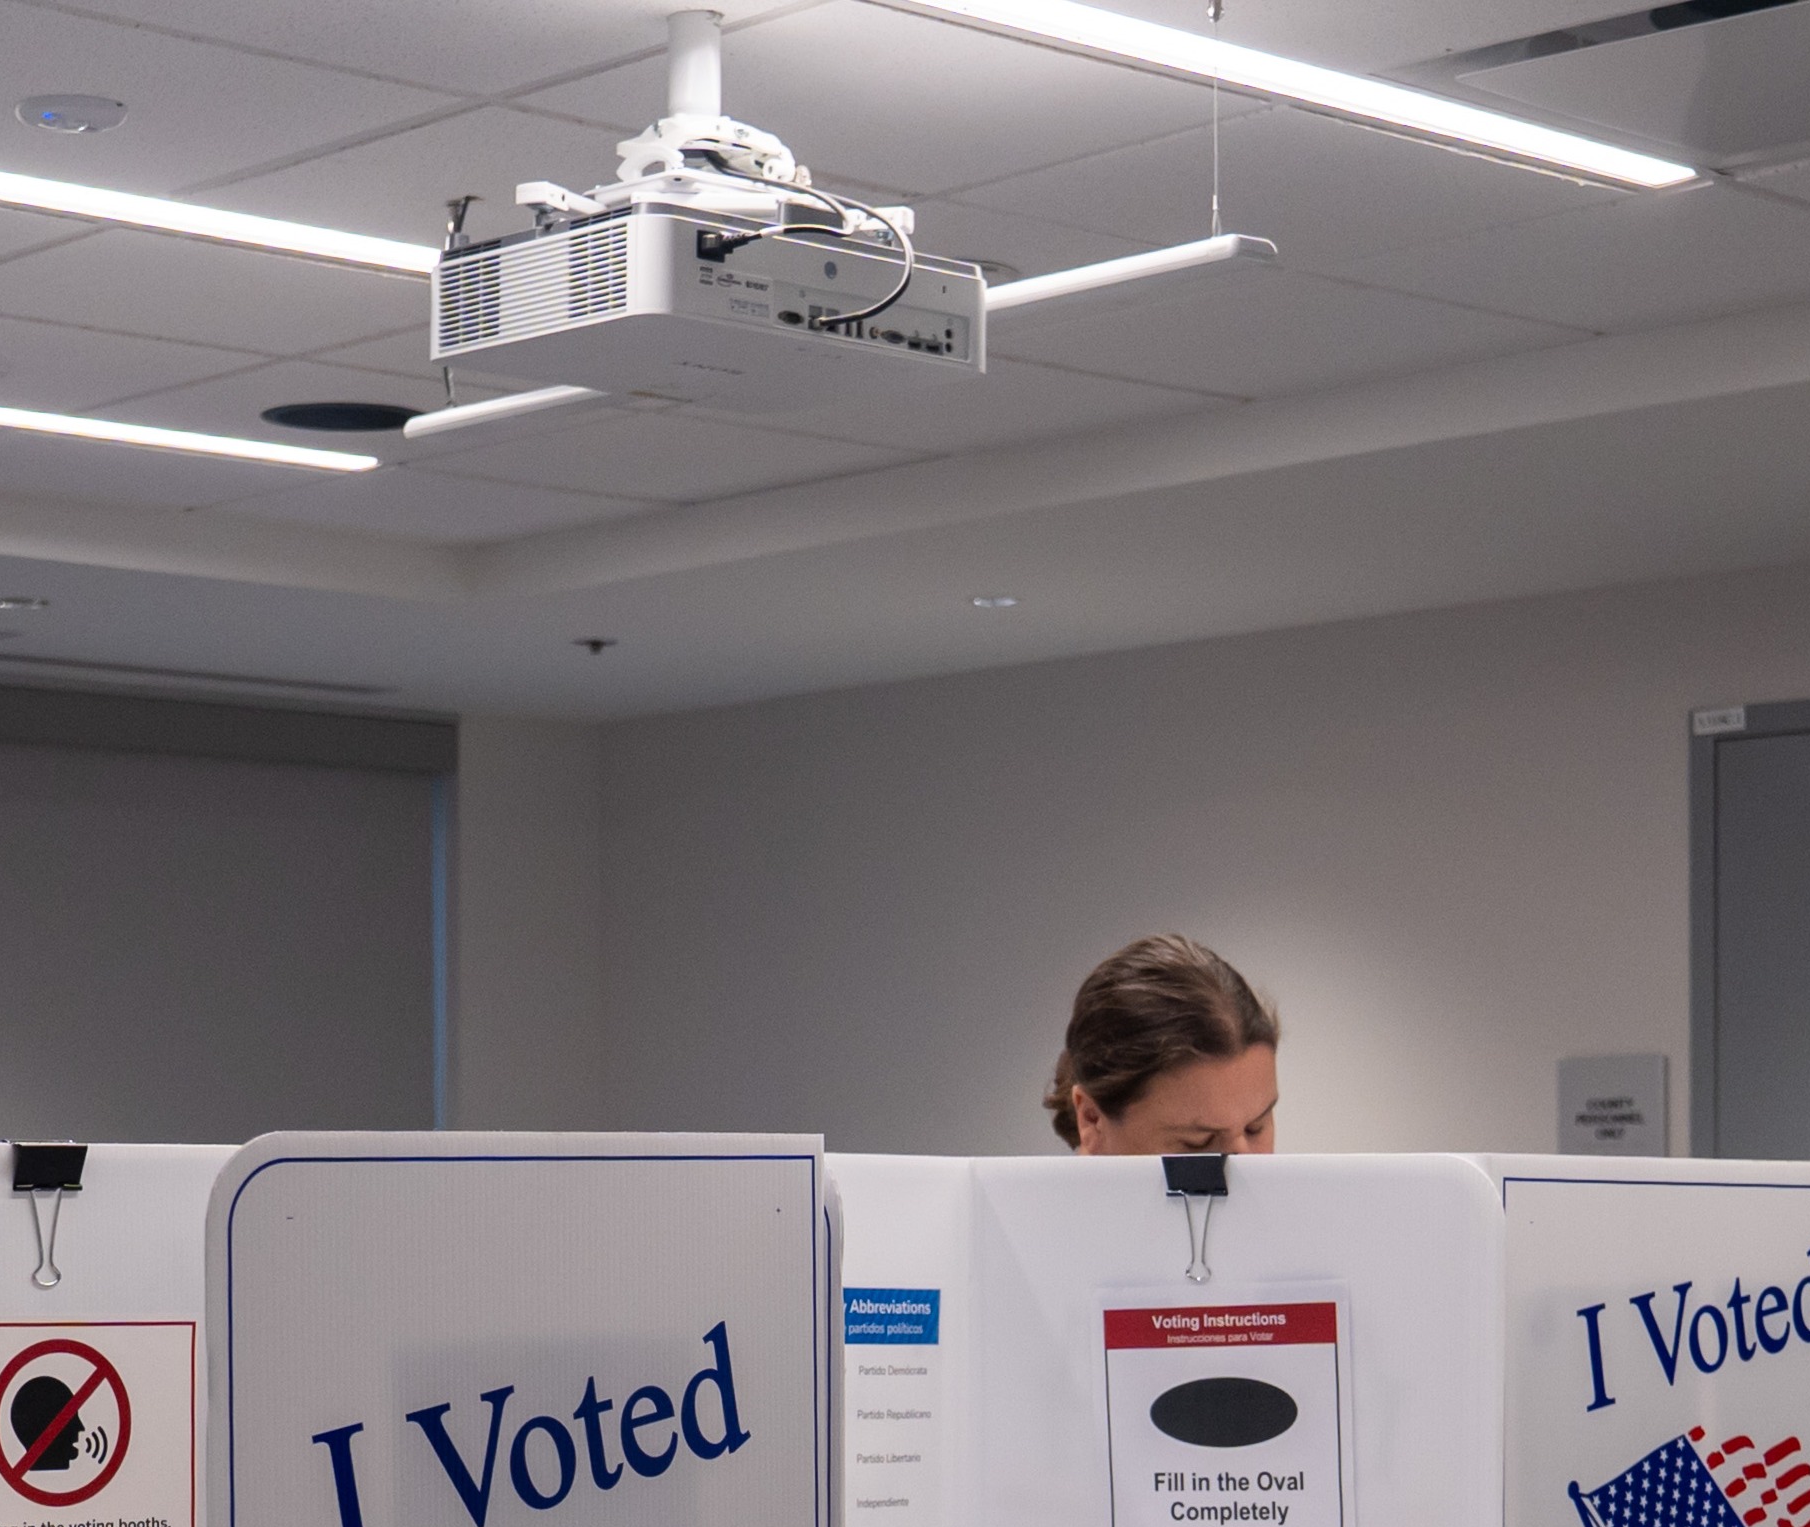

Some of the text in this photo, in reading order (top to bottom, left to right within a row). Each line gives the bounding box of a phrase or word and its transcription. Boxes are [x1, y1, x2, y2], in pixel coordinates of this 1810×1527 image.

[850, 1299, 931, 1315] Abbreviations
[1152, 1312, 1286, 1331] Voting Instructions
[848, 1322, 884, 1335] partidos
[1167, 1332, 1274, 1344] Instrucciones para Votar
[1576, 1302, 1616, 1413] I
[858, 1365, 886, 1376] Partido
[857, 1409, 931, 1421] Partido Republicano
[856, 1453, 921, 1464] Partido Libertario
[1154, 1471, 1304, 1491] Fill in the Oval
[856, 1497, 909, 1510] Independiente
[1170, 1501, 1289, 1526] Completely
